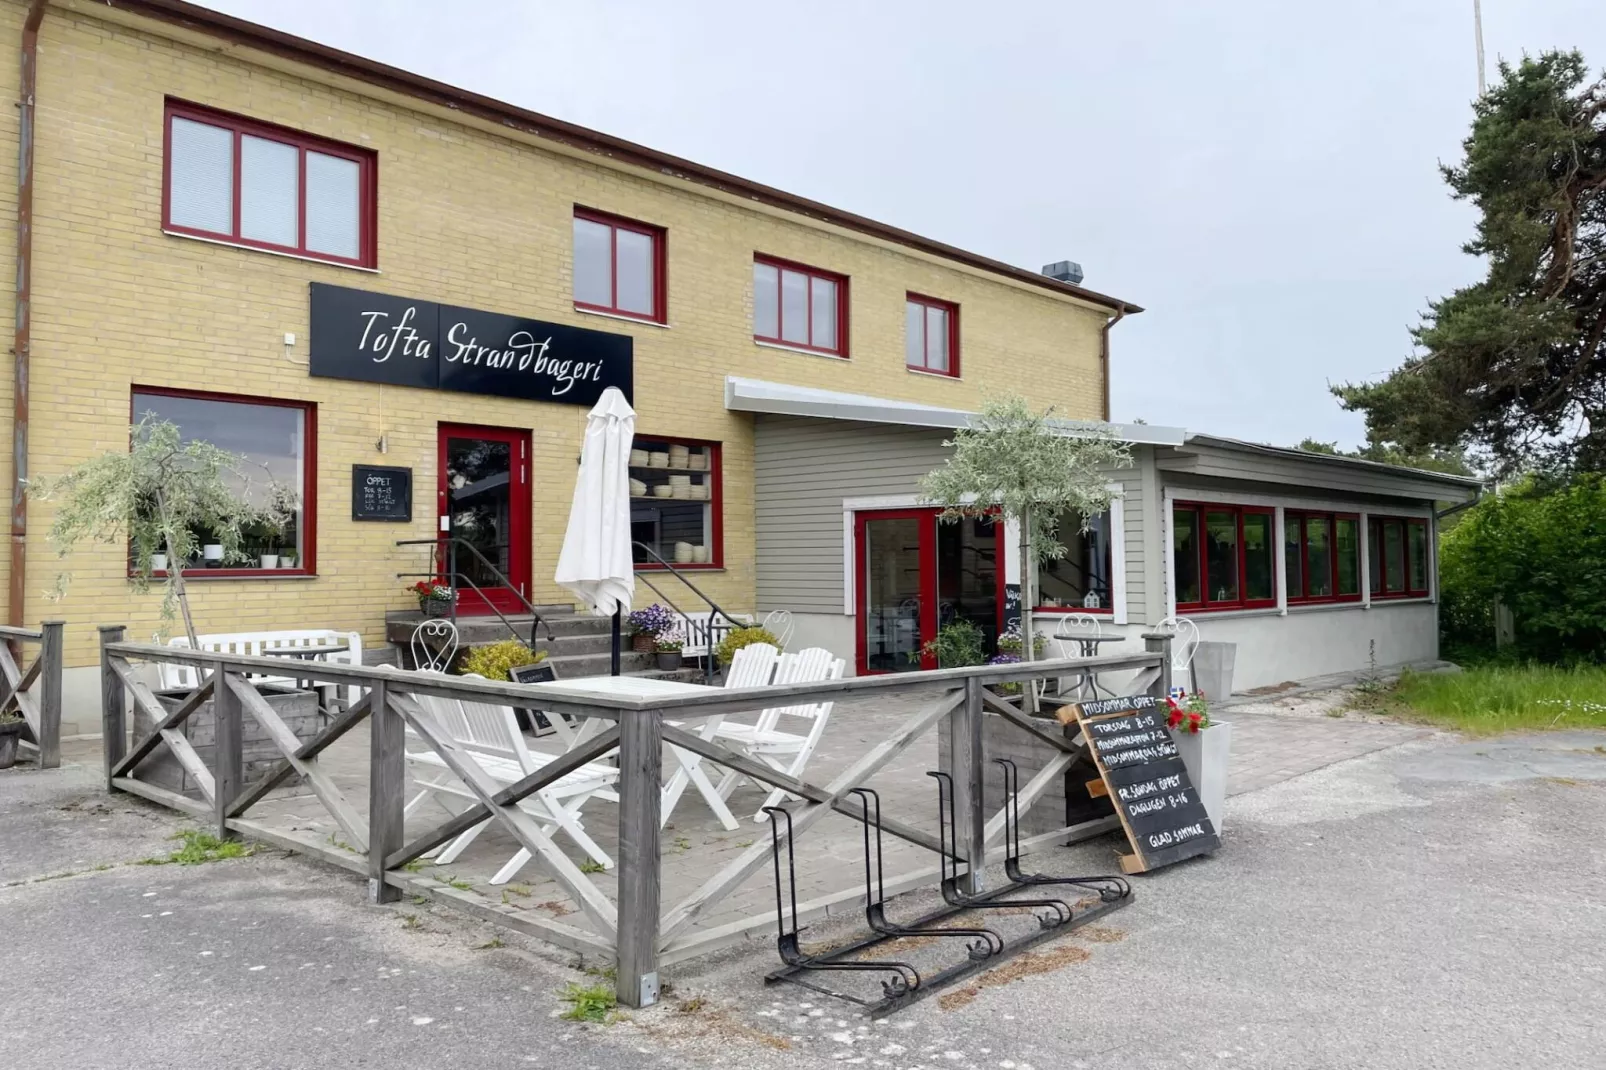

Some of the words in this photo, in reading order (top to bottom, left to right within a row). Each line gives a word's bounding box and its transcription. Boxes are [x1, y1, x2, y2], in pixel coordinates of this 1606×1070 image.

[358, 306, 431, 363] Tofta
[445, 322, 603, 396] Strandbageri
[1082, 698, 1135, 716] MIDSOMMAR
[1094, 720, 1131, 733] TORSDAG
[1135, 716, 1155, 729] 8-15
[1158, 774, 1181, 791] ÖPPET
[1168, 792, 1188, 808] 8-16
[1149, 832, 1173, 848] GLAD
[1173, 823, 1205, 842] SOMMAR
